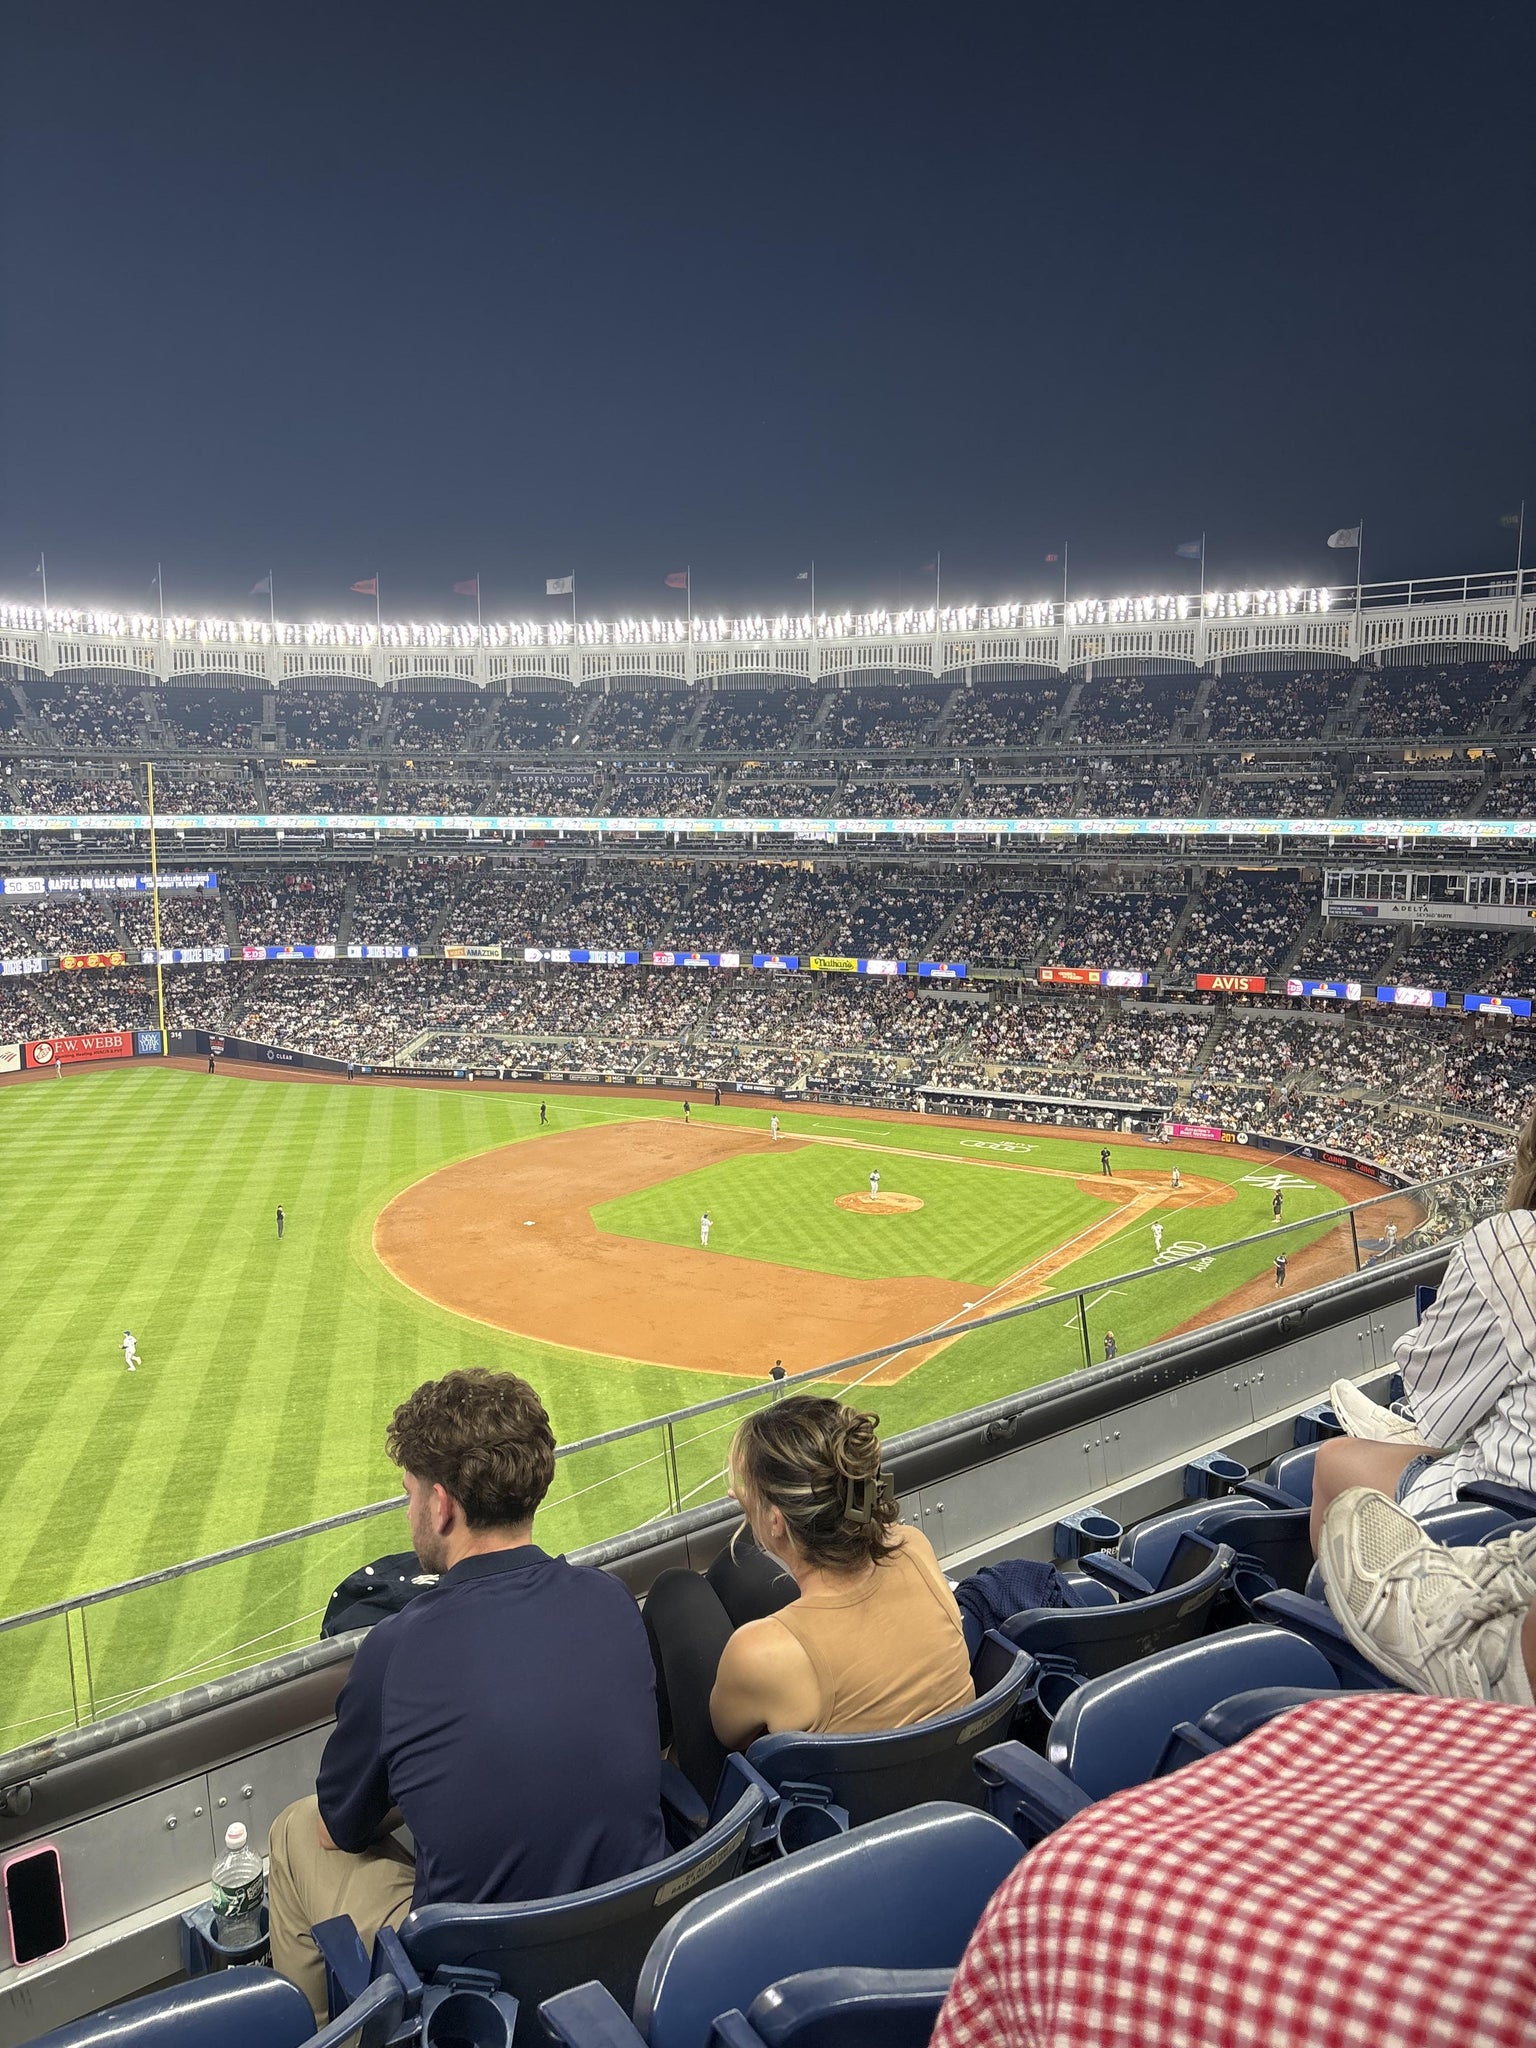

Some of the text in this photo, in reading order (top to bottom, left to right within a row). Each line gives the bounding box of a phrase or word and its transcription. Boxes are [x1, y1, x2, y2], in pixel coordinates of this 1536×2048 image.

[557, 775, 588, 784] VODKA
[629, 776, 703, 784] ASPEN VODKA
[48, 879, 79, 890] RAFFLE
[80, 878, 93, 889] ON
[94, 878, 115, 889] SALE
[1401, 904, 1429, 912] DELTA
[466, 949, 499, 957] AMAZING
[814, 957, 854, 969] Nathan's
[1211, 977, 1249, 990] AVIS
[54, 1036, 123, 1054] F.W. WEBB
[1221, 1133, 1235, 1142] 207
[1322, 1153, 1347, 1166] Canon
[1355, 1162, 1375, 1175] Canon
